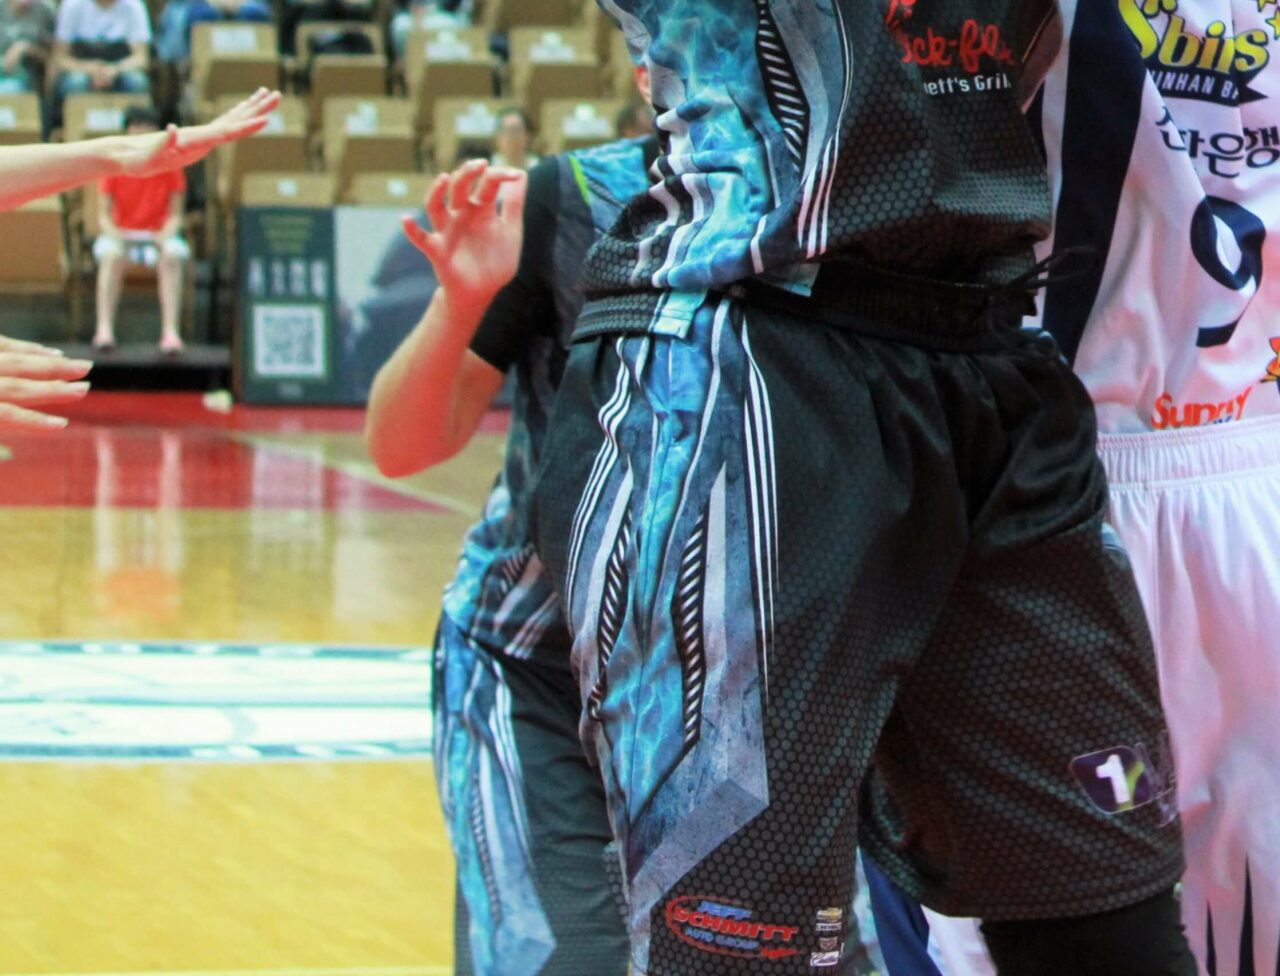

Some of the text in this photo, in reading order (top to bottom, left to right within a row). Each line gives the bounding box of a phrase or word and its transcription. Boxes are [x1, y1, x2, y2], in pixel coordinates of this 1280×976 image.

[974, 73, 1011, 91] Gril
[673, 908, 798, 941] SCHMITT
[684, 926, 714, 943] AUTO
